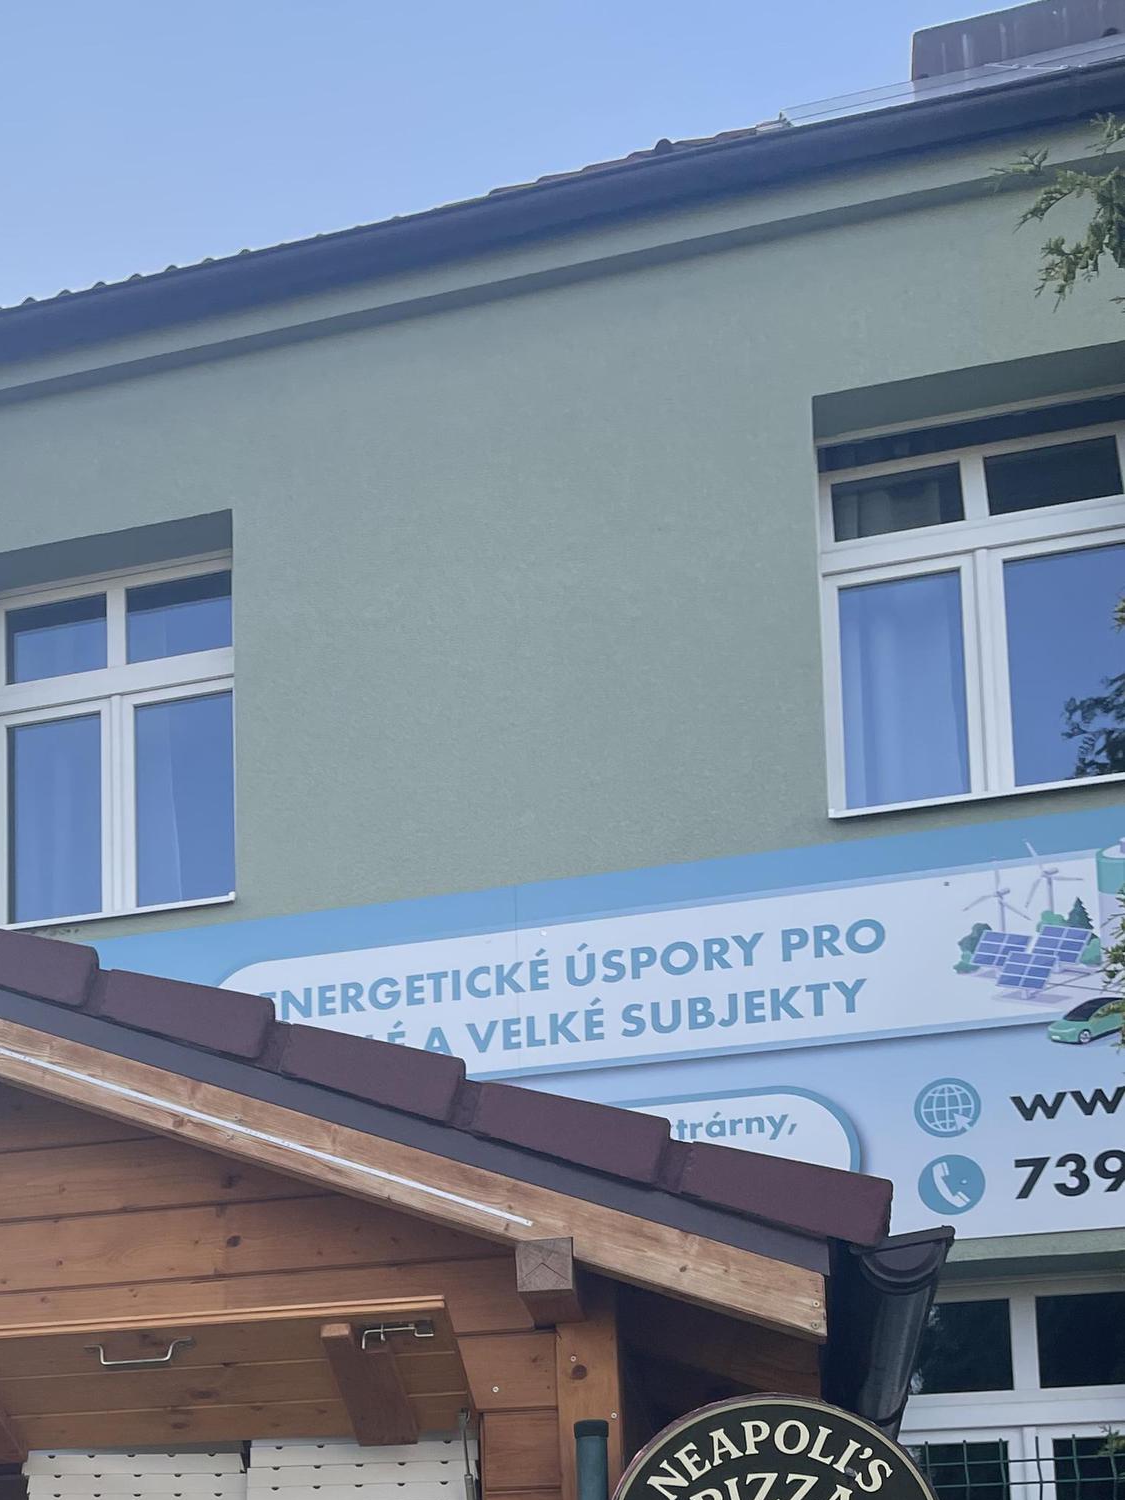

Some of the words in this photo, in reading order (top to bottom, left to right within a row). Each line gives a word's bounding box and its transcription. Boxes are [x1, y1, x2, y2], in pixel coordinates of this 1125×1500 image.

[566, 943, 764, 986] ÚSPORY
[781, 919, 885, 962] PRO
[425, 1027, 454, 1057] A
[465, 997, 605, 1054] VELKÉ
[621, 978, 867, 1037] SUBJEKTY
[672, 1112, 797, 1140] trárny,
